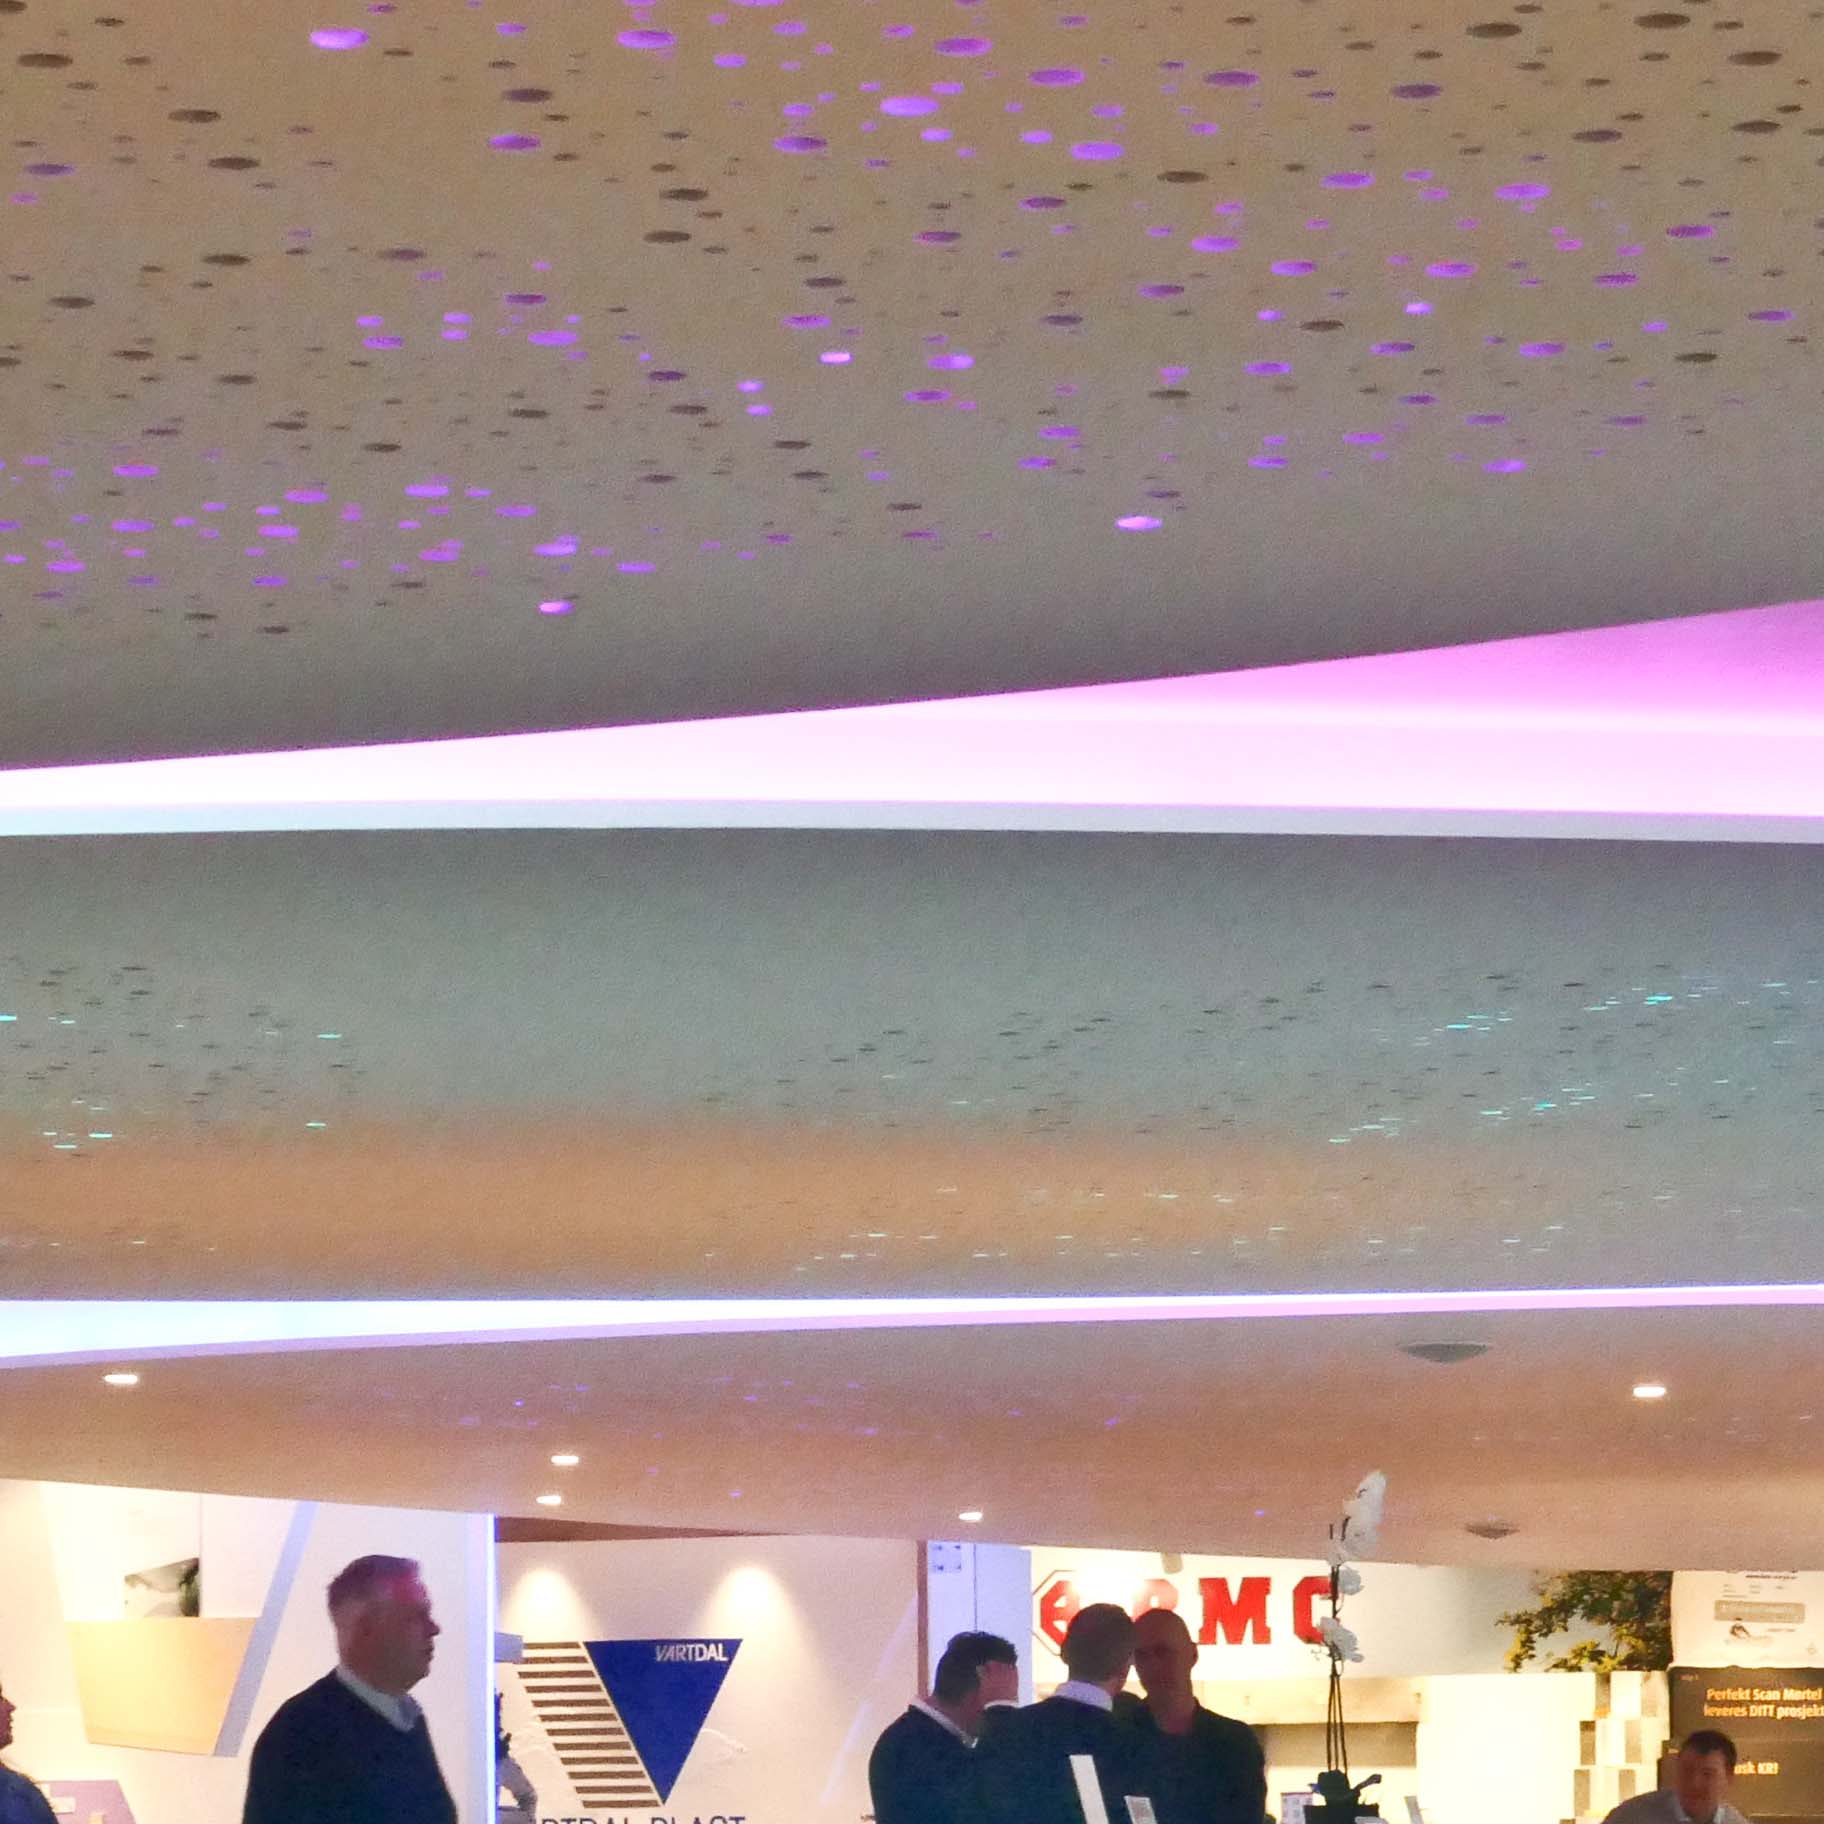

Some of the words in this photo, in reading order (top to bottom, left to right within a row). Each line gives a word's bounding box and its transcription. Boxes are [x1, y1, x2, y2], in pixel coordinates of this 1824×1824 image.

[656, 1642, 729, 1662] VARTDAL
[1707, 1687, 1751, 1701] Perfekt
[1753, 1687, 1780, 1701] Scan
